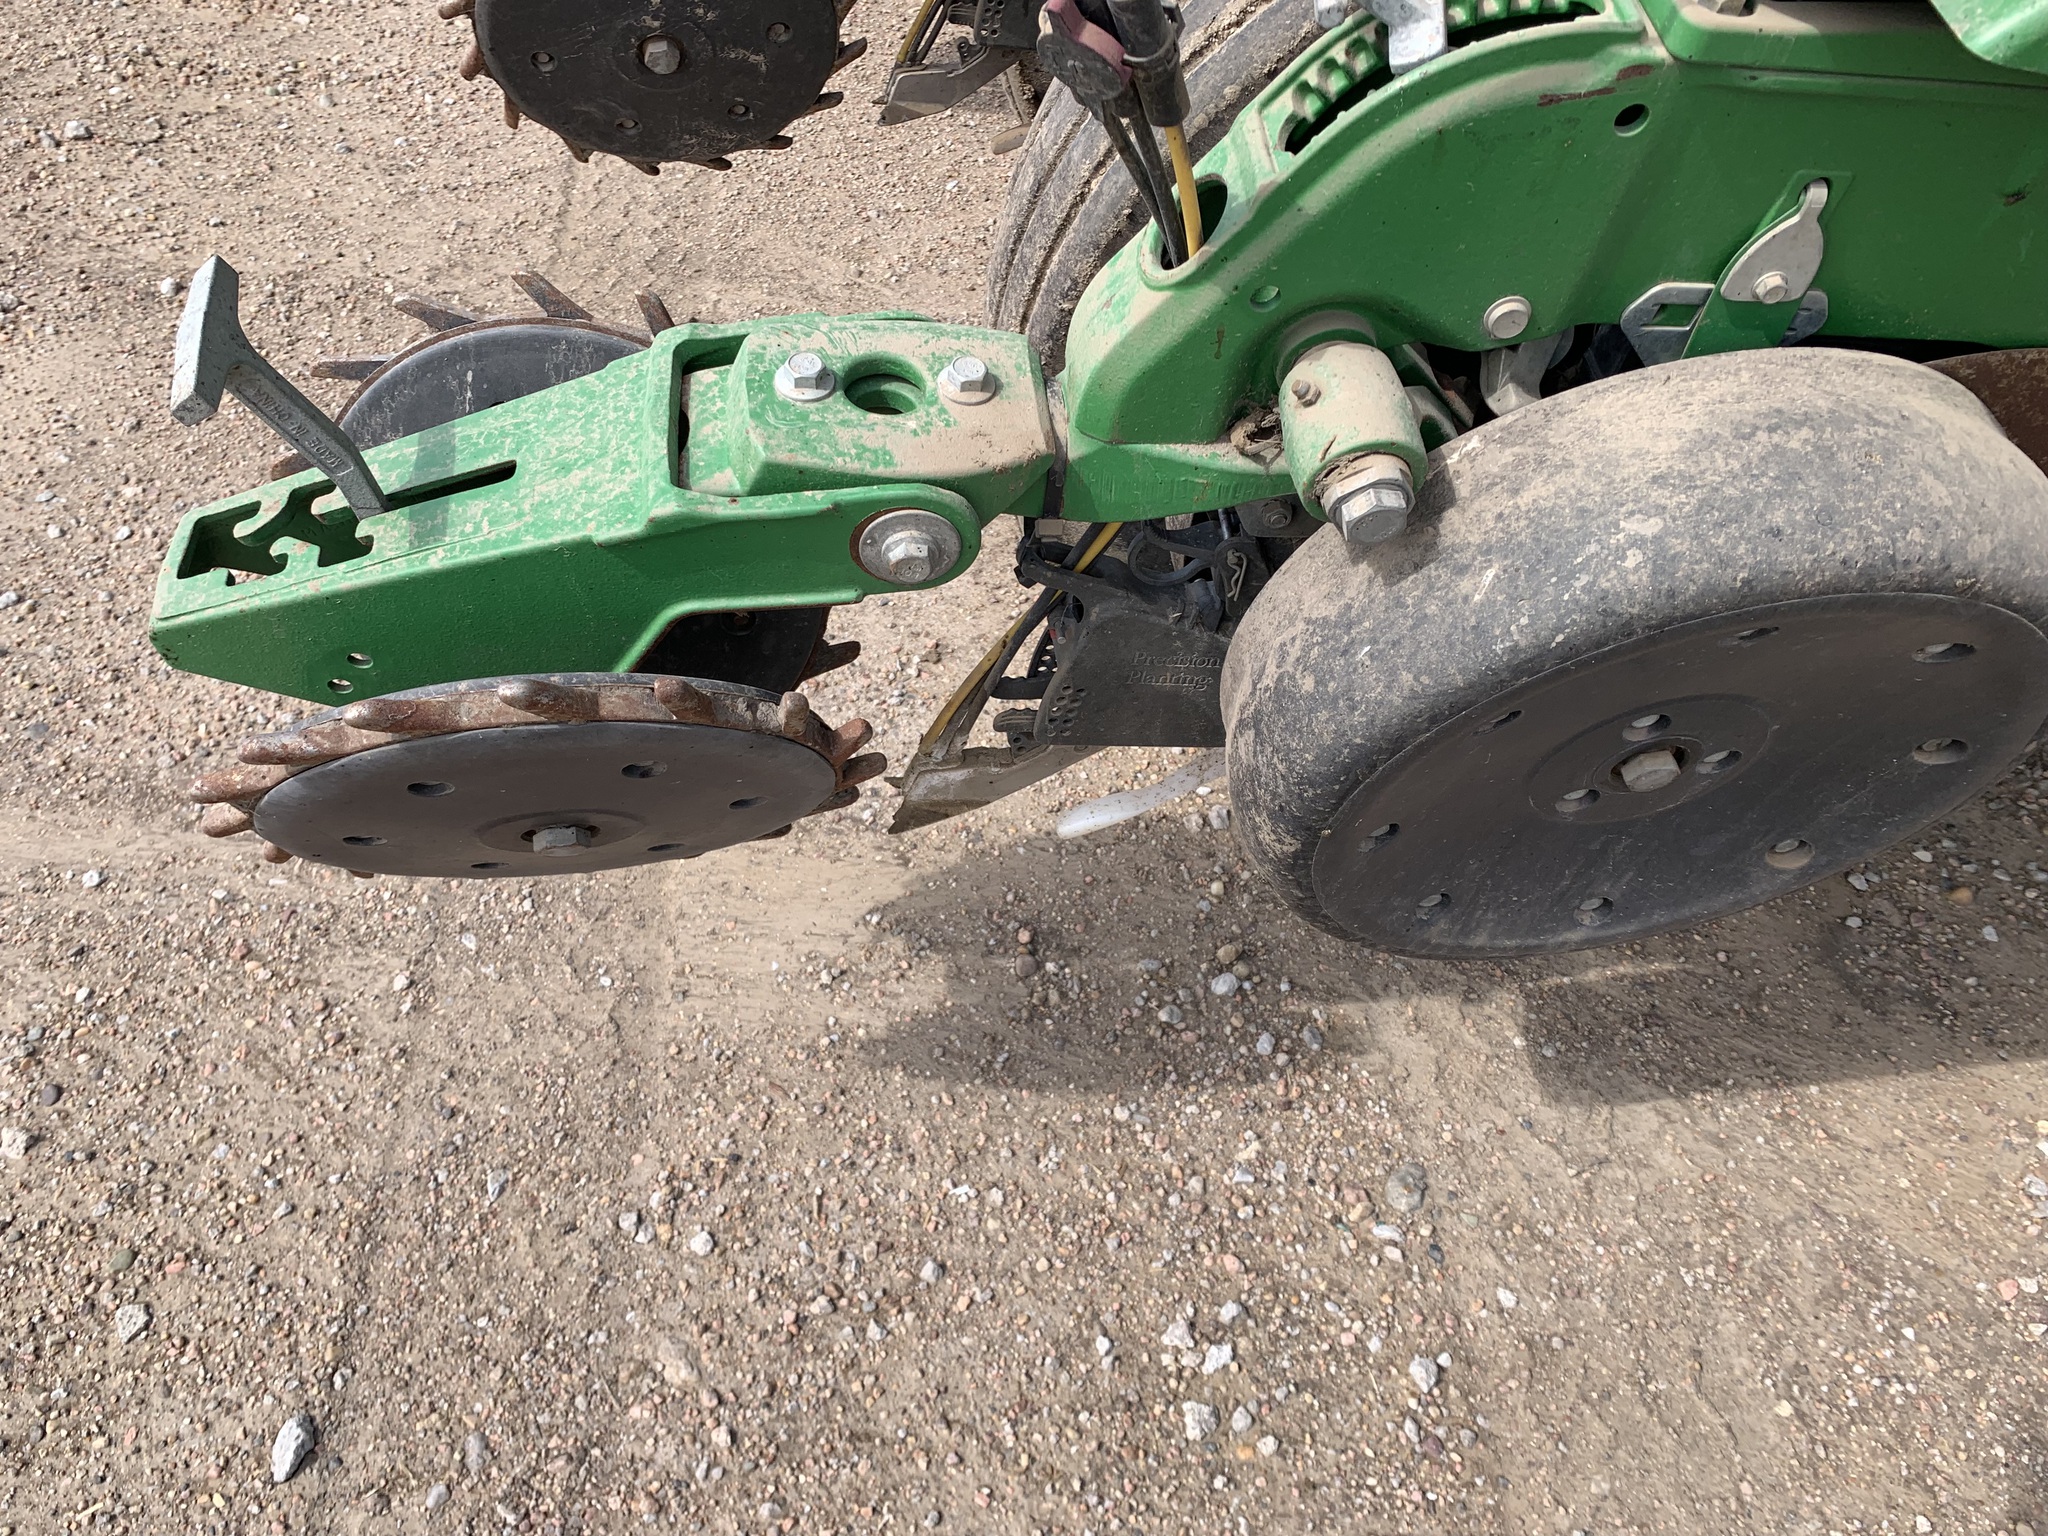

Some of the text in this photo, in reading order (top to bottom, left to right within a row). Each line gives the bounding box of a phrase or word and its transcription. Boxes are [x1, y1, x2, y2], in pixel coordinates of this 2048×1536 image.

[251, 386, 343, 467] MADE IN CHINA
[1130, 651, 1221, 669] Precision
[1125, 670, 1213, 692] Planting
